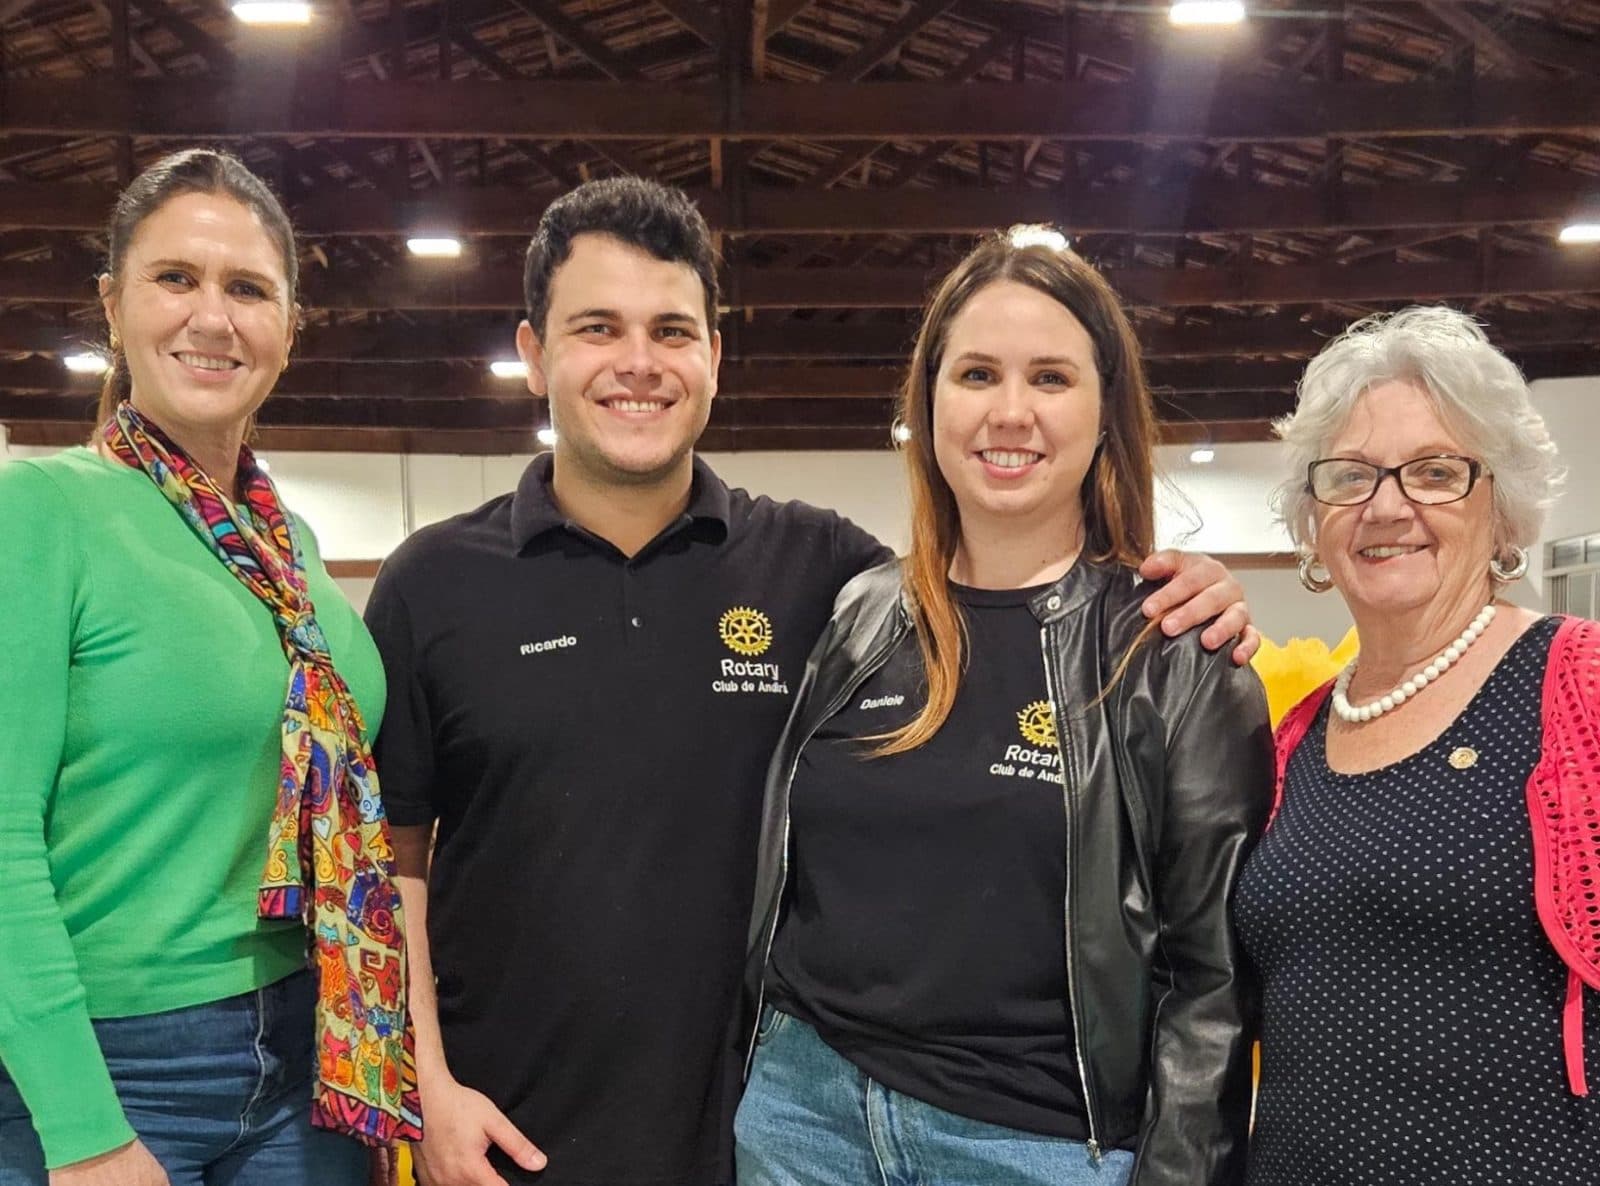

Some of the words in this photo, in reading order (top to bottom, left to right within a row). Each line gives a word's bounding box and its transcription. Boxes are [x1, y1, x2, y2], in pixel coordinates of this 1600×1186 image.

[520, 635, 577, 655] Ricardo
[720, 659, 779, 680] Rotary
[712, 680, 739, 692] Club
[741, 680, 755, 692] de
[860, 694, 905, 709] Daniele
[1004, 745, 1060, 767] Rotar
[989, 763, 1016, 776] Club
[1018, 766, 1035, 778] de
[1036, 769, 1065, 785] And
